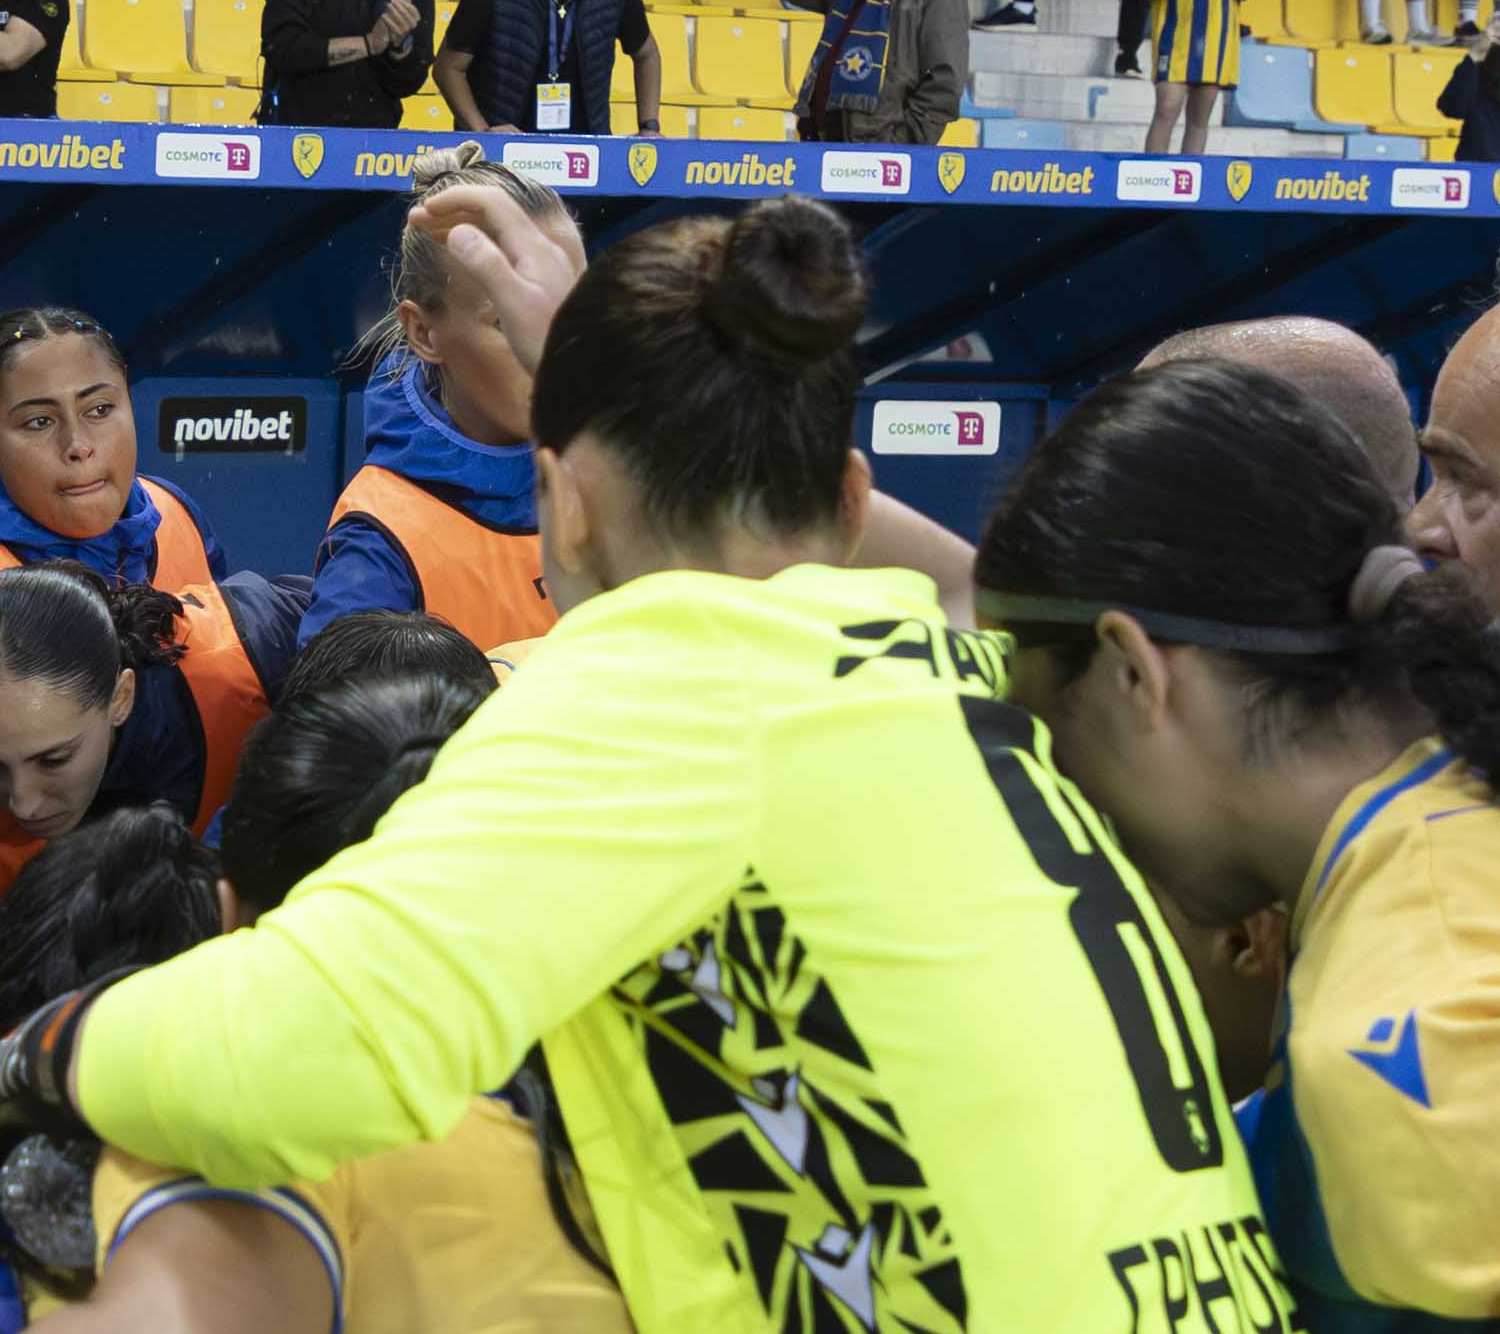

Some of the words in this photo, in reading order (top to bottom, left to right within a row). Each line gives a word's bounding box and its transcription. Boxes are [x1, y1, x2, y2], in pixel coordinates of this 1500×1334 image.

[165, 150, 223, 163] COSMOTE
[355, 145, 434, 177] nov
[511, 159, 563, 172] COSMOTE
[685, 154, 795, 186] novibet
[991, 164, 1094, 194] novibet
[1275, 172, 1370, 201] novibet
[173, 408, 293, 443] novibet
[887, 422, 951, 436] COSMOTE
